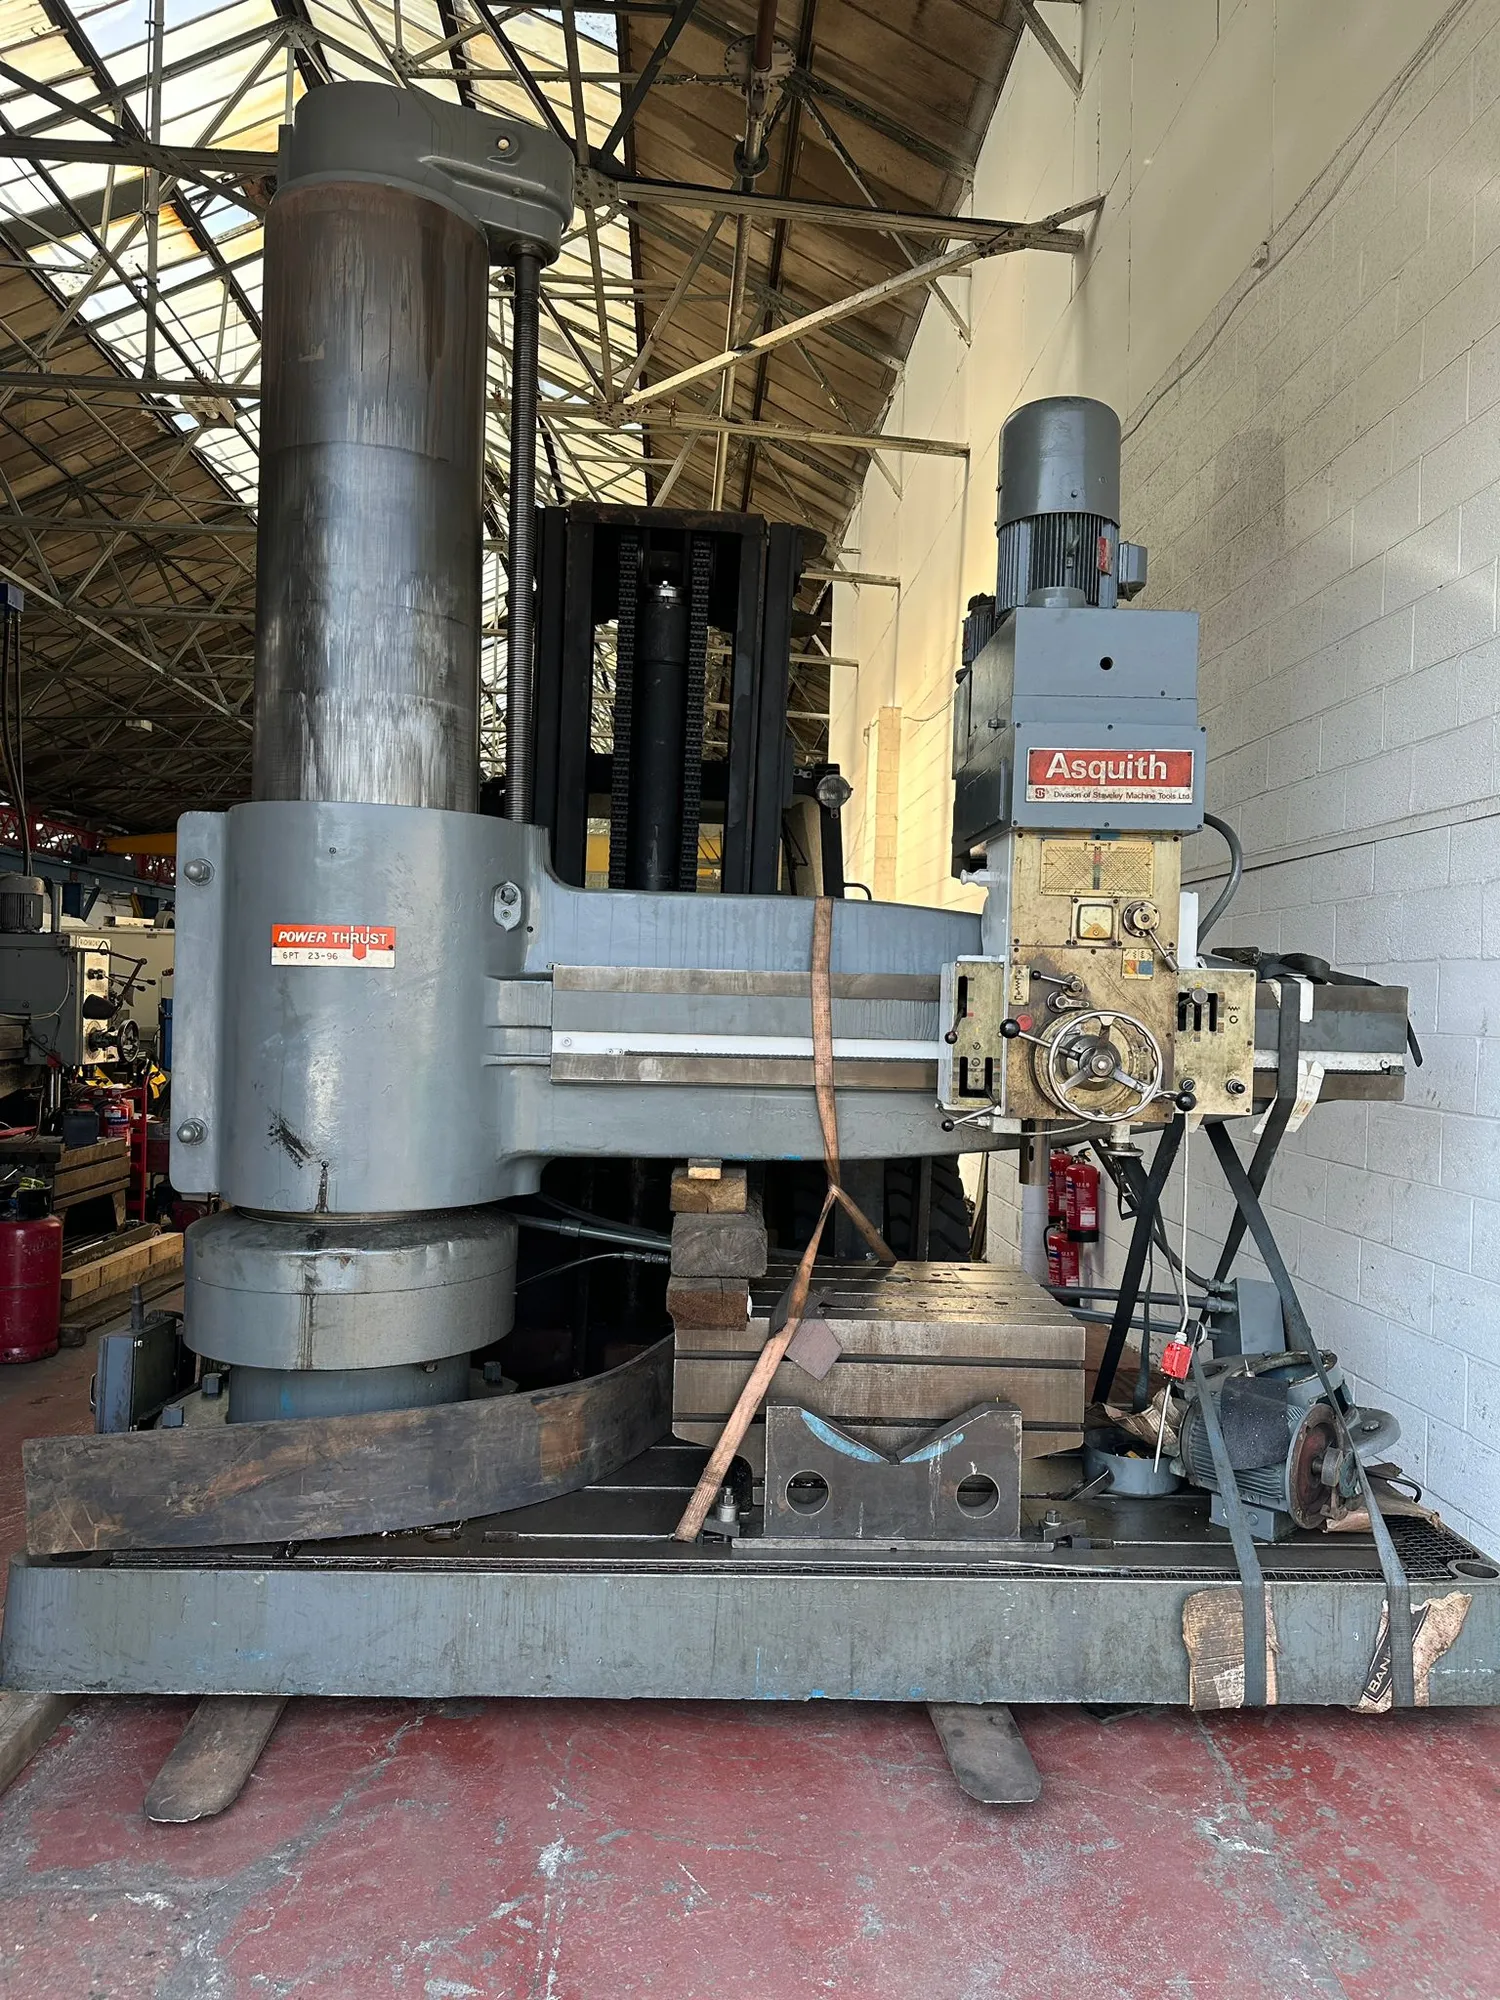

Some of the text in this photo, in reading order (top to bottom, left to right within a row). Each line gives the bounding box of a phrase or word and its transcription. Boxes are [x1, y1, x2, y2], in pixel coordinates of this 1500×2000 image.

[1045, 752, 1167, 785] Asquith
[1053, 790, 1082, 799] Division
[1083, 791, 1091, 799] of
[1093, 791, 1124, 800] Staveley
[1126, 792, 1156, 800] Machine
[1158, 792, 1177, 800] Tools
[278, 931, 388, 945] POWER THRUST
[282, 951, 339, 960] 6PT 23-96
[1368, 1646, 1391, 1693] BAN
